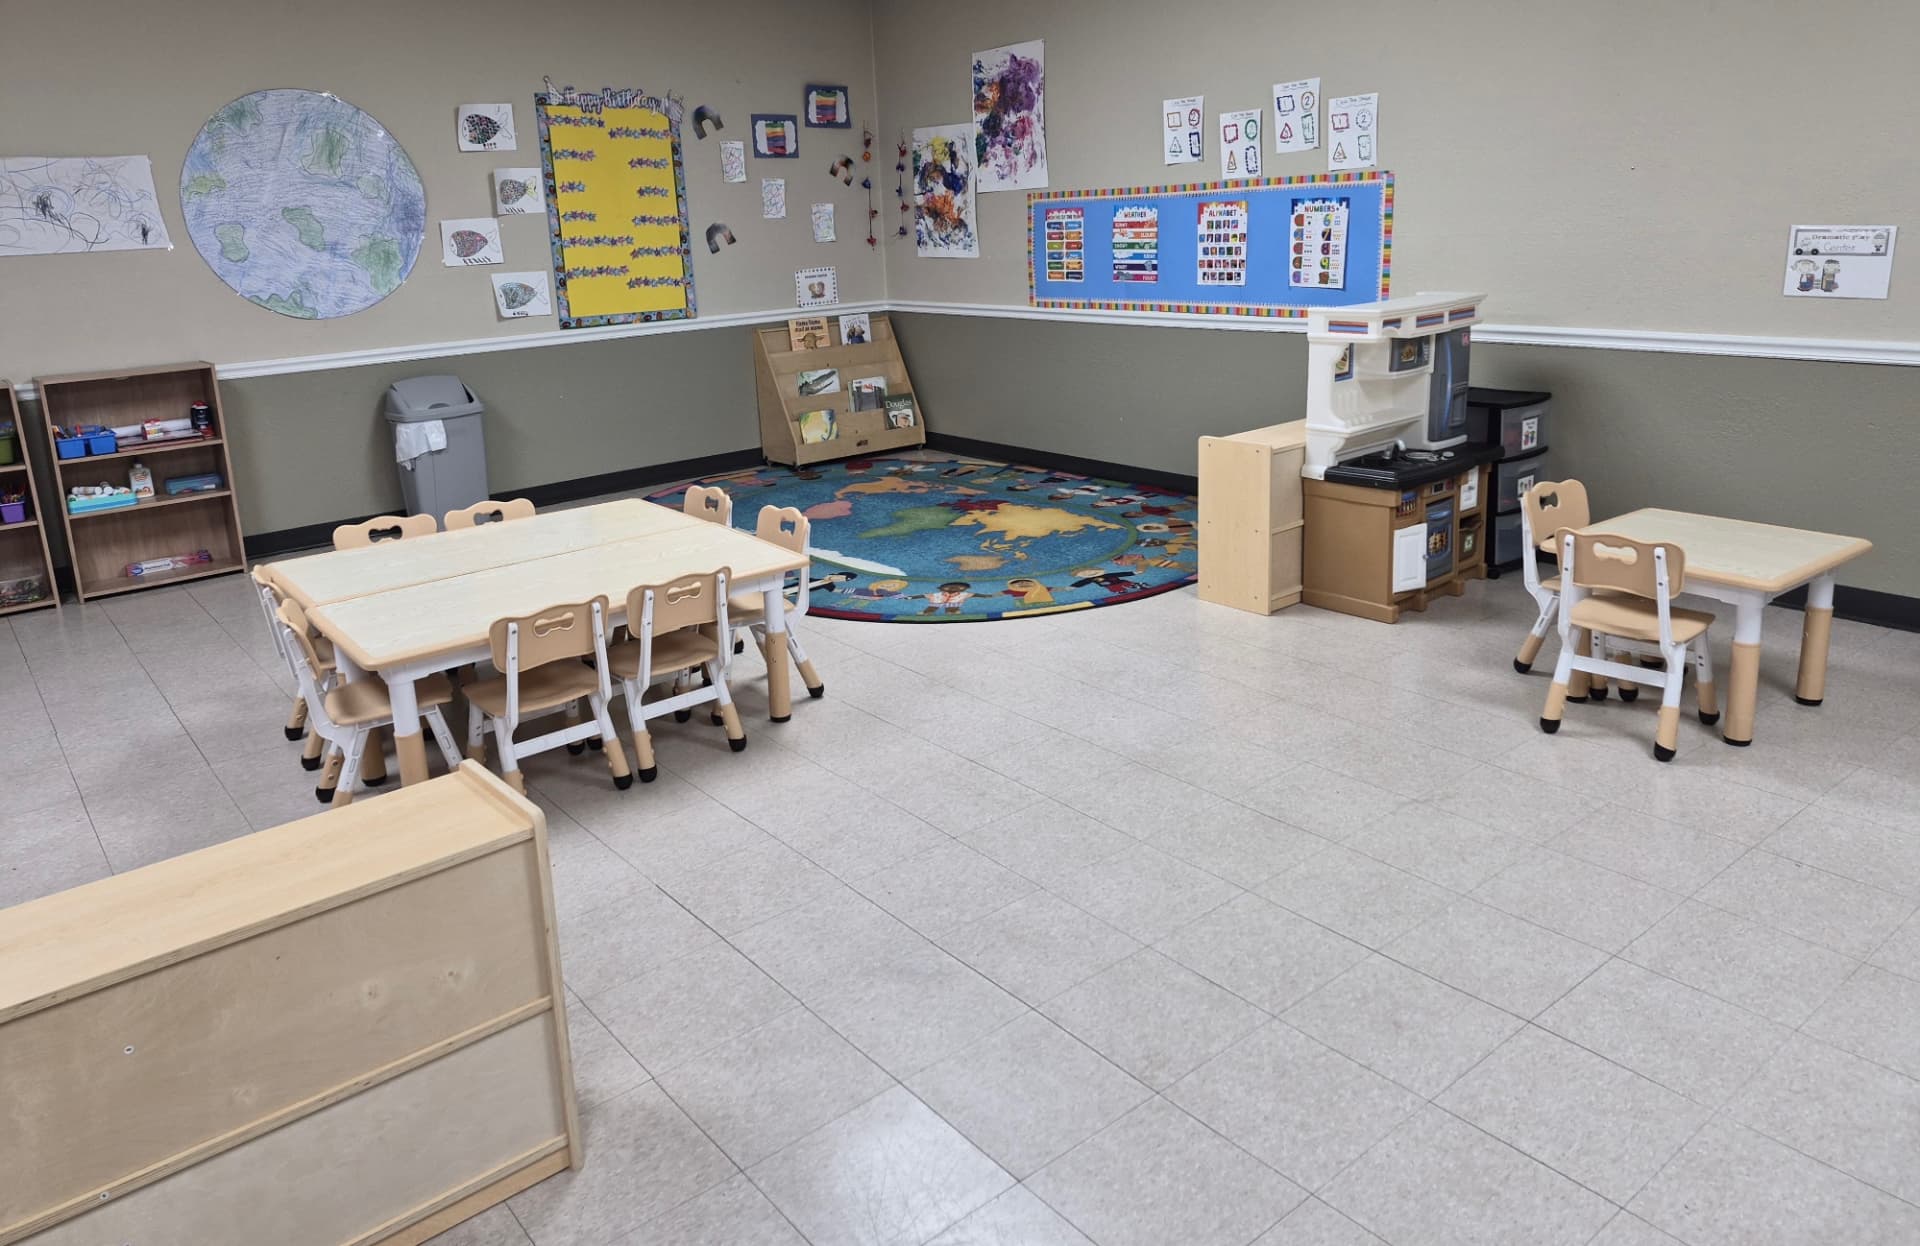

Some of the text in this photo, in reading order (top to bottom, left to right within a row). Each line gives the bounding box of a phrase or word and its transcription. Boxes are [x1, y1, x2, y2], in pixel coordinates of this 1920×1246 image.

[1304, 95, 1310, 106] 2
[1361, 114, 1368, 124] 2
[1208, 209, 1237, 217] ALPHABET
[1304, 204, 1336, 213] NUMBERS
[1323, 213, 1334, 227] 6
[1321, 242, 1331, 256] 8
[885, 398, 912, 409] Douglas
